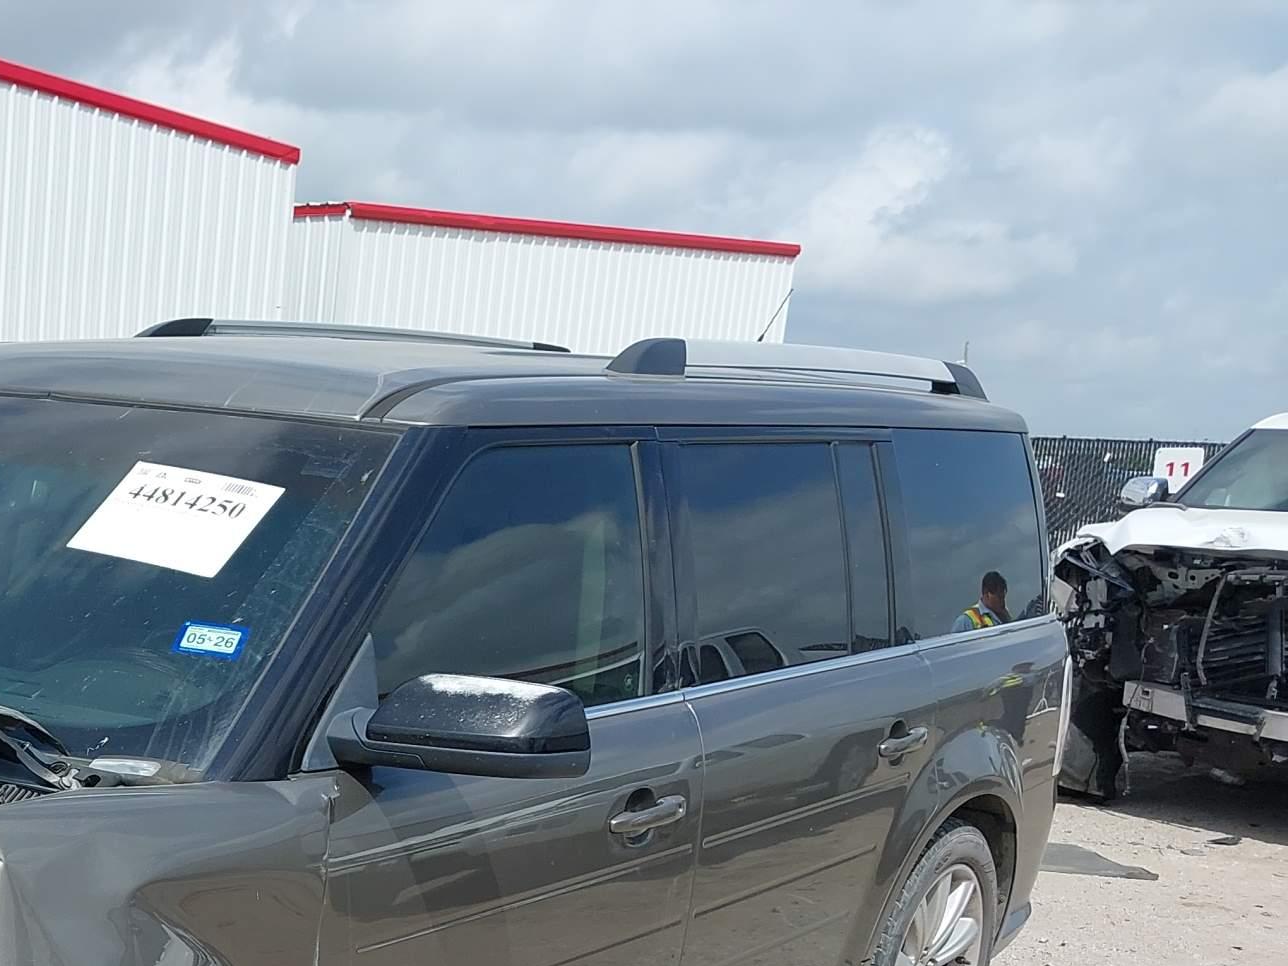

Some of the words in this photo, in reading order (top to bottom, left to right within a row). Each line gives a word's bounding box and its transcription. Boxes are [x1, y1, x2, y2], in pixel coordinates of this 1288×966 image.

[1165, 461, 1191, 478] 11
[128, 483, 247, 519] 44814250
[186, 632, 208, 646] 05
[213, 635, 236, 649] 26
